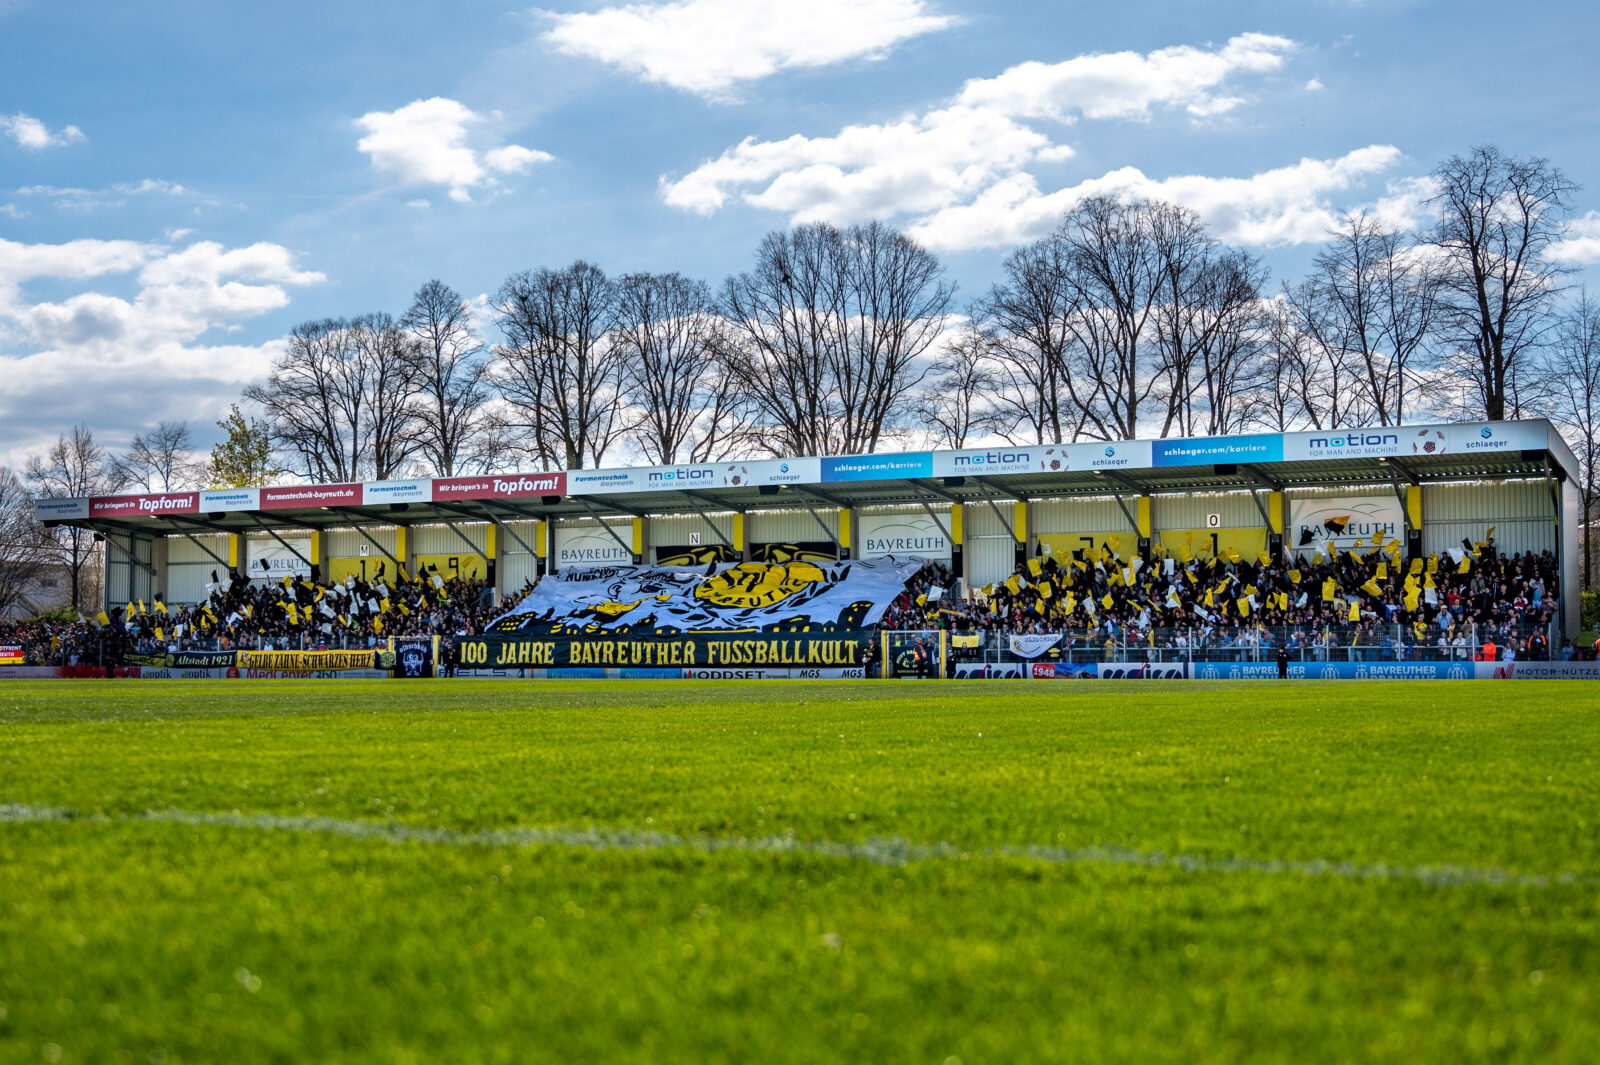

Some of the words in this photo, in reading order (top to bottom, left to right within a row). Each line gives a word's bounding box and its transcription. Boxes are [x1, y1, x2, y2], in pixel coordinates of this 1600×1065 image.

[1309, 434, 1398, 448] motion
[1465, 439, 1508, 448] schlaeger
[1164, 444, 1266, 456] schlaeger.com/karriere
[954, 452, 1030, 465] motion
[1092, 458, 1128, 467] schlaeger
[834, 462, 923, 472] schlaeger.com/karriere
[575, 474, 629, 482] Formentechnik
[649, 469, 714, 482] motion
[769, 474, 800, 482] schlaeger
[451, 483, 481, 493] bringen's
[493, 477, 559, 495] Topform!
[267, 490, 354, 501] formentechnik-bayreuth.de
[139, 496, 193, 513] Topform!
[691, 534, 699, 544] N
[866, 537, 944, 552] BAYREUTH
[361, 546, 368, 554] M
[561, 548, 627, 563] BAYREUTH
[461, 642, 487, 664] 100
[497, 642, 555, 665] JAHRE
[569, 641, 696, 665] BAYREUTHER
[176, 656, 209, 665] Altstadt
[211, 655, 233, 665] 1921
[249, 654, 273, 669] GELBE
[350, 653, 371, 668] HERZ
[697, 670, 766, 679] ODDSET
[800, 669, 820, 678] MGS
[841, 669, 862, 678] MGS
[1034, 667, 1055, 678] 1948
[1243, 666, 1305, 675] BAYREUHER
[1370, 666, 1436, 675] BAYREUTHER
